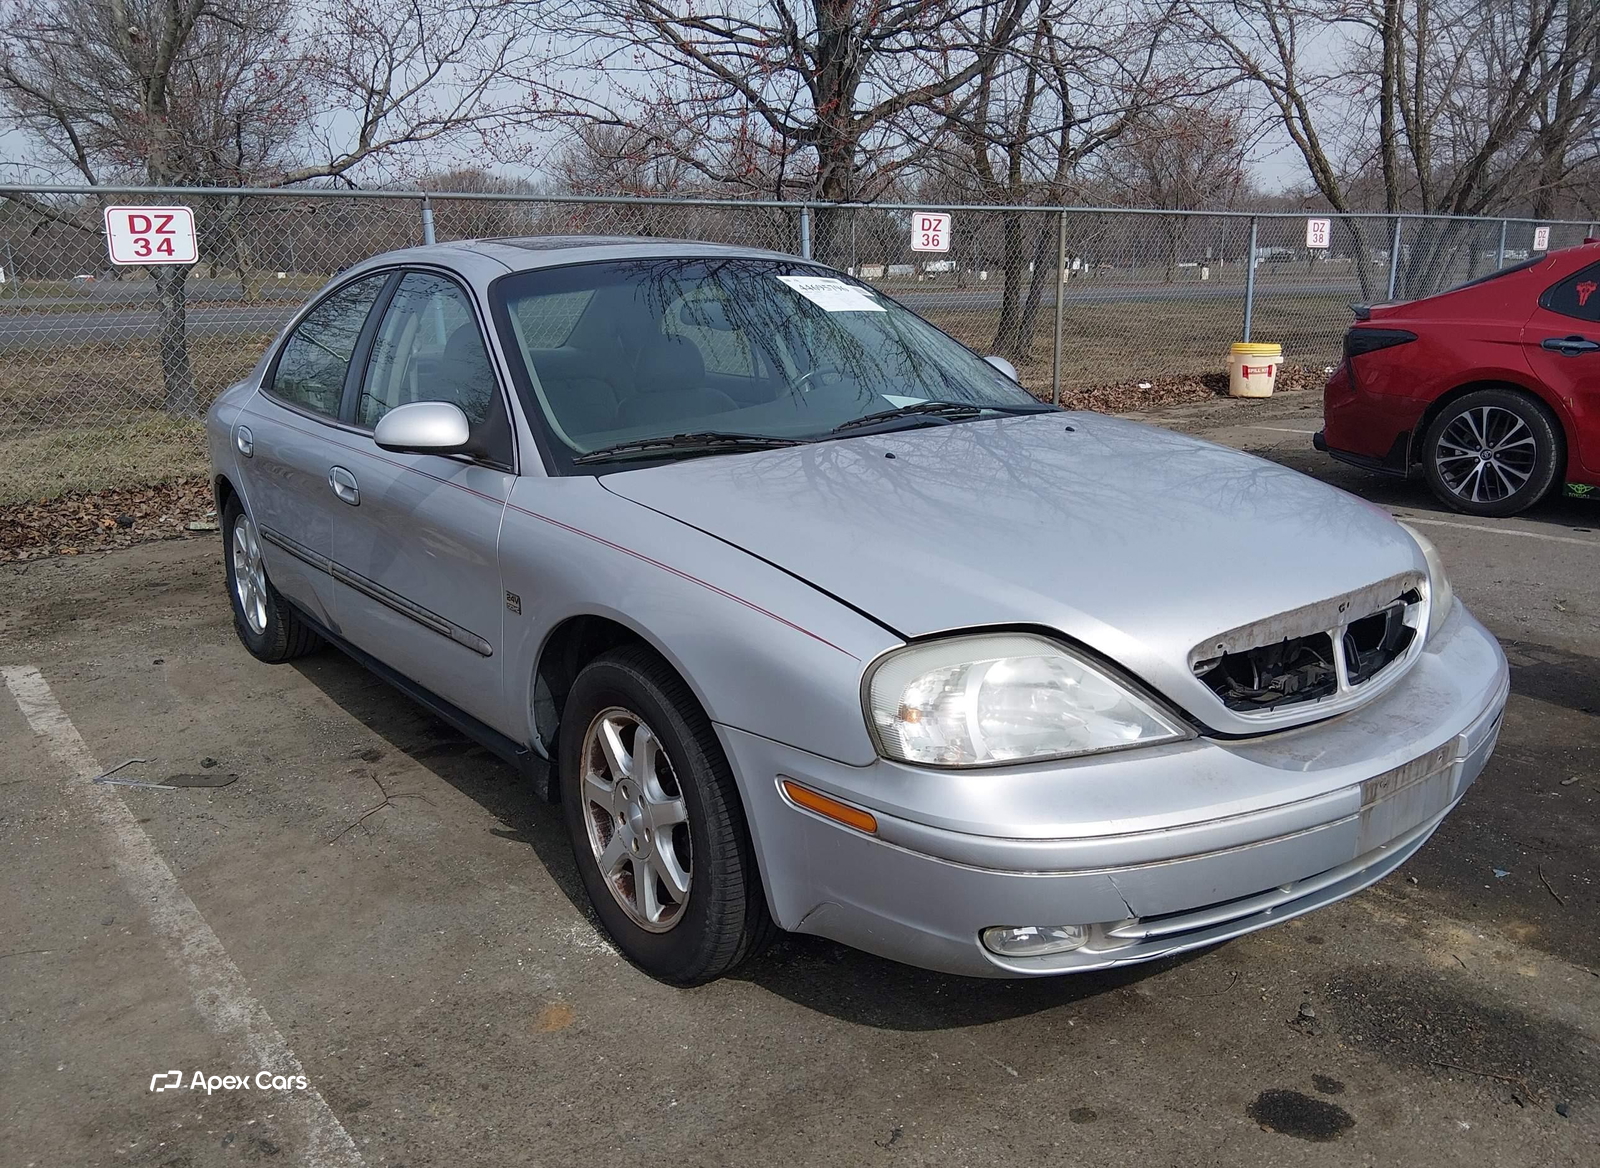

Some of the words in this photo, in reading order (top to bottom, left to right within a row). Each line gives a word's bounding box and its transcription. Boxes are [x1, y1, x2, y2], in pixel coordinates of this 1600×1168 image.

[127, 214, 176, 235] DZ
[921, 217, 943, 232] DZ
[1312, 222, 1326, 233] DZ
[921, 233, 940, 247] 36
[1312, 233, 1324, 243] 38
[1537, 230, 1547, 239] DZ
[132, 237, 176, 257] 34
